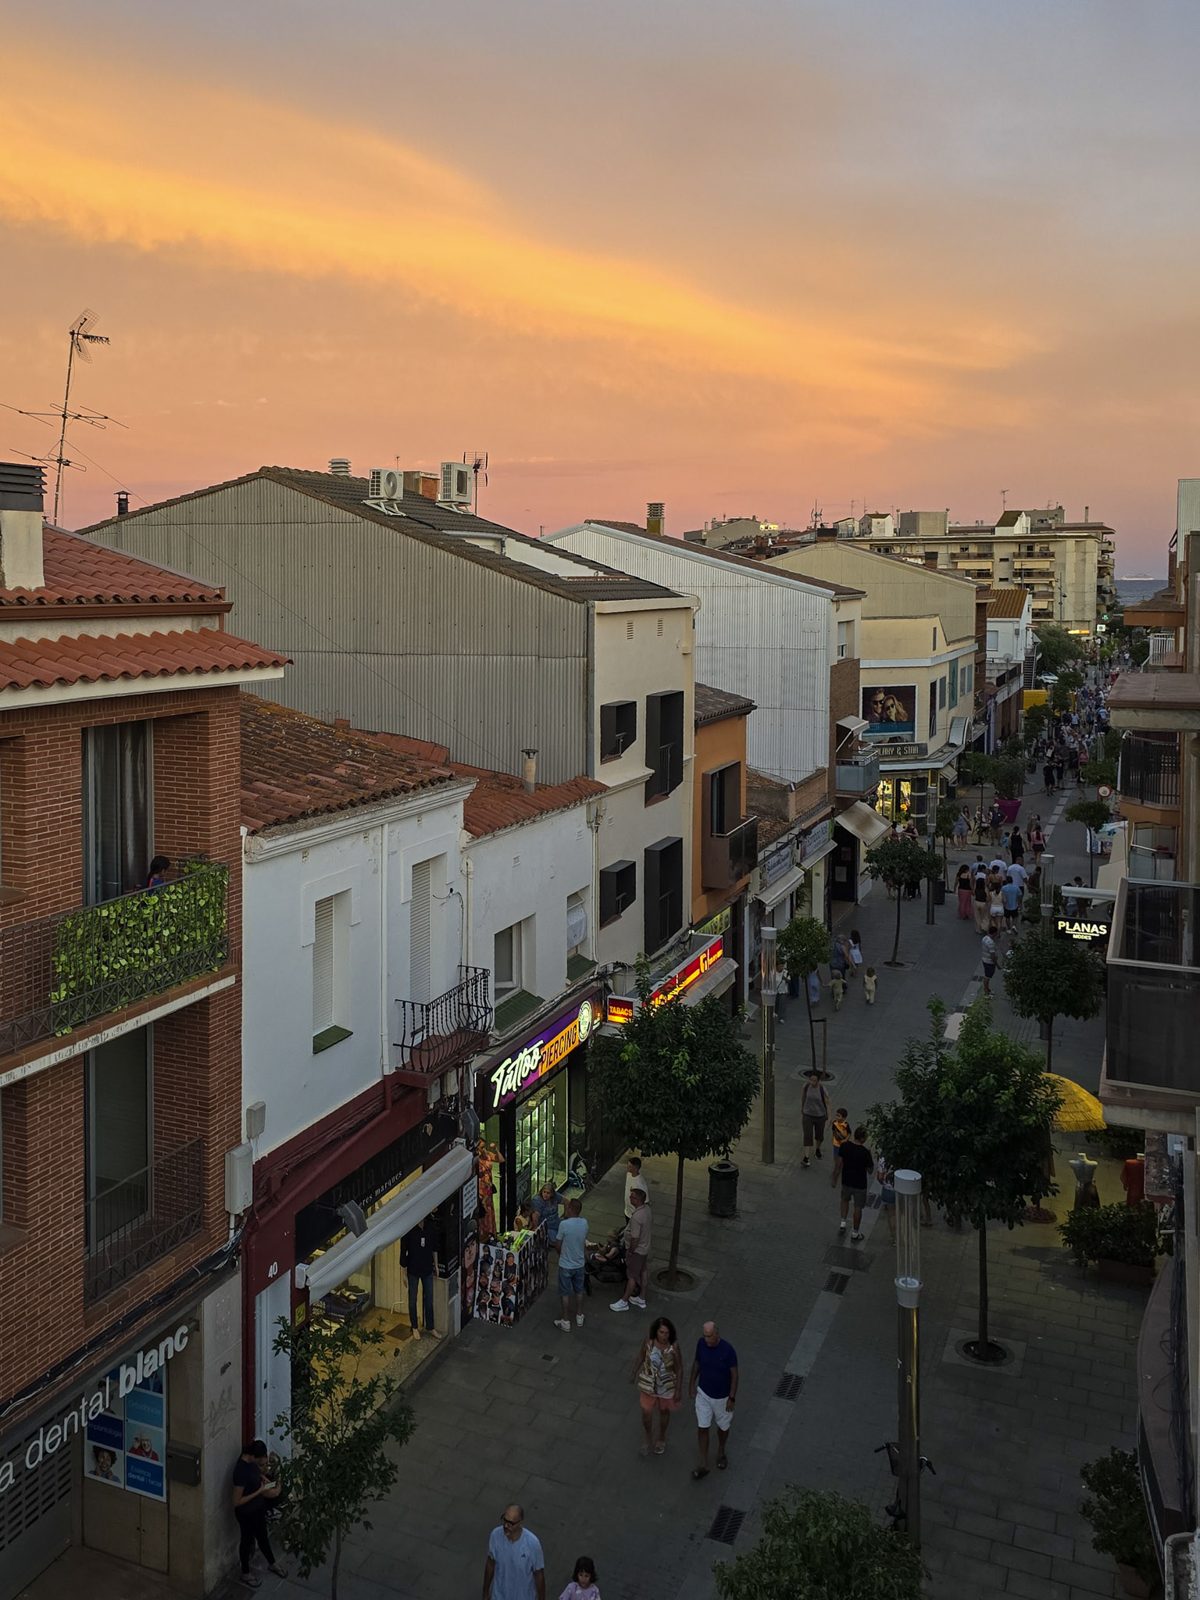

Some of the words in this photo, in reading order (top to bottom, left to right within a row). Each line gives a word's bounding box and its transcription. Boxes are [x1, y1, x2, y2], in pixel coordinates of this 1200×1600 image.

[1057, 920, 1107, 935] PLANAS
[609, 1005, 633, 1017] TABACS
[491, 1040, 544, 1108] Tattoo
[540, 1024, 577, 1075] PIERCING
[374, 1170, 403, 1197] marques
[267, 1261, 279, 1279] 40
[25, 1376, 110, 1470] dental
[119, 1325, 189, 1398] blanc
